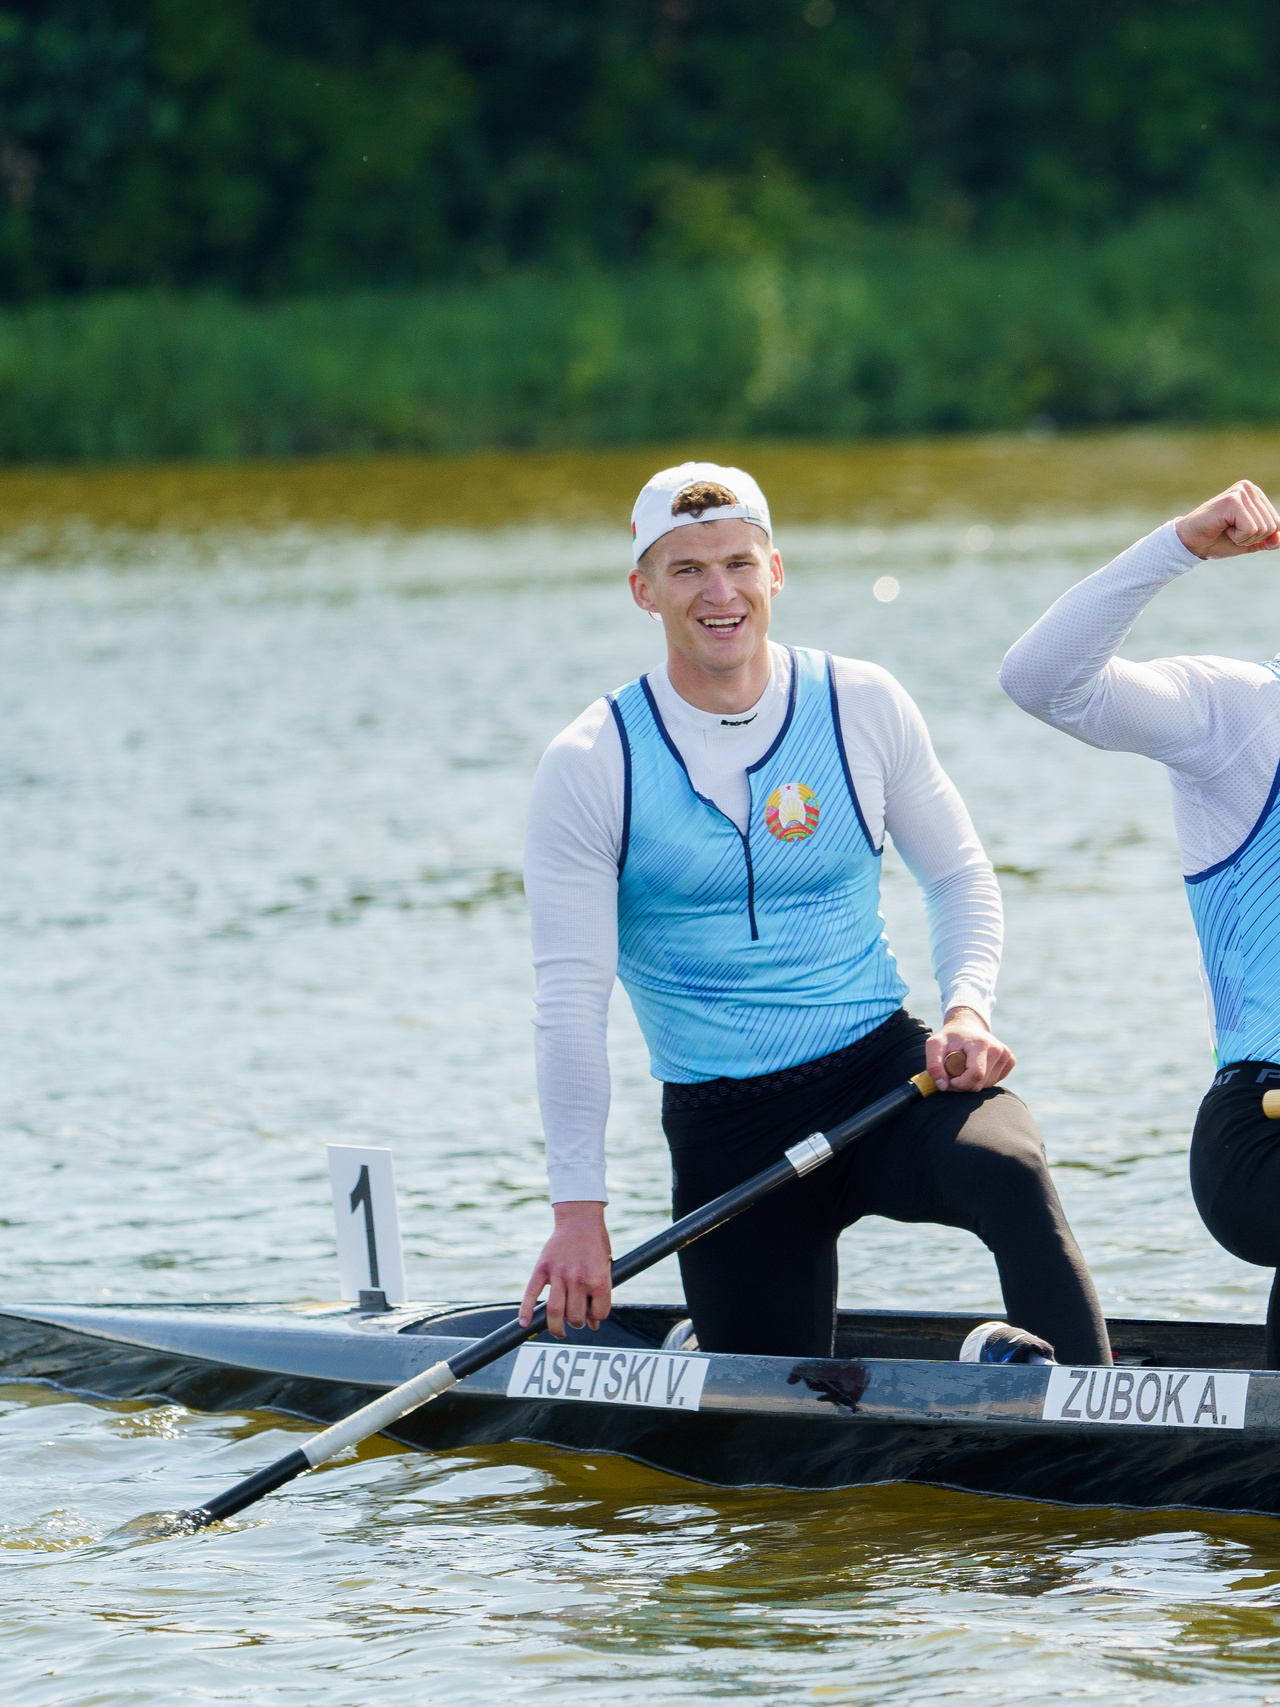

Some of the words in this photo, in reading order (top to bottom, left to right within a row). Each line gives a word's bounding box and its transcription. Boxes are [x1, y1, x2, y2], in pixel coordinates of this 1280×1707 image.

[349, 1164, 380, 1289] 1
[522, 1349, 659, 1403] ASETSKI
[666, 1358, 690, 1406] V.
[1060, 1370, 1190, 1423] ZUBOK
[1192, 1375, 1228, 1425] A.
